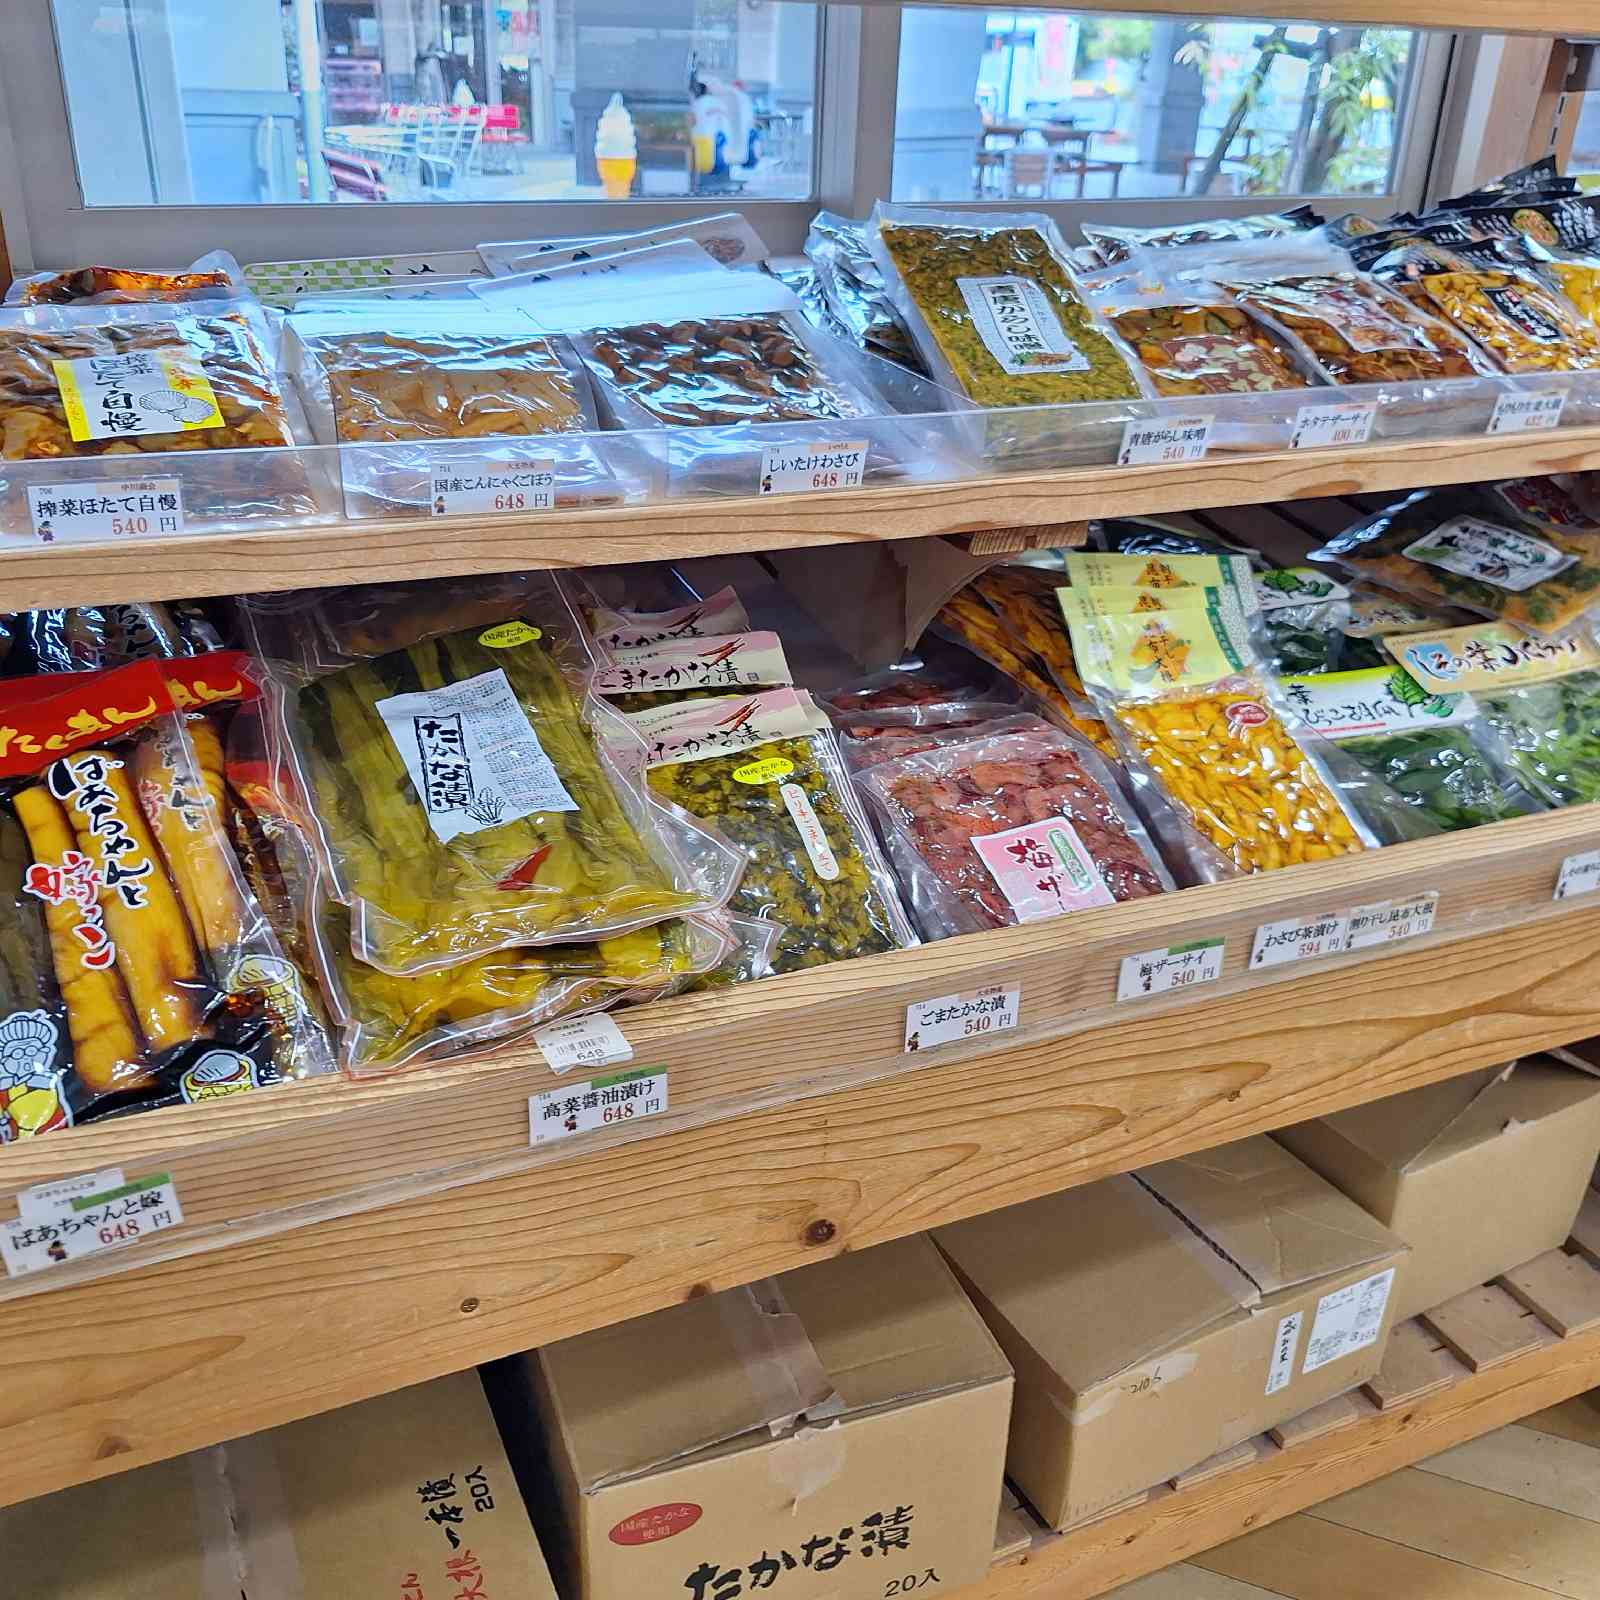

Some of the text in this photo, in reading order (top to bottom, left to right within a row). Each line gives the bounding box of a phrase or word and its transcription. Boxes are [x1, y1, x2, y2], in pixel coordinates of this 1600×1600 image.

[769, 452, 860, 473] しいたけわさび
[1163, 446, 1185, 459] 540
[434, 473, 553, 493] 国産こんにゃくごぼう
[812, 471, 858, 488] 648 円
[36, 493, 179, 519] 搾菜ほたて自慢
[495, 493, 548, 509] 648 円
[112, 516, 178, 536] 540 円
[598, 658, 743, 690] ごまたかな漬
[421, 720, 470, 808] たかな漬
[1171, 969, 1195, 986] 540
[920, 994, 1008, 1027] ごまたかな漬
[964, 1012, 1012, 1035] 540 円
[603, 1098, 660, 1123] 648 円
[10, 1190, 166, 1251] ばあちゃんと嫁
[99, 1210, 172, 1245] 648 円
[683, 1504, 914, 1600] たかな漬
[884, 1568, 941, 1598] 20入
